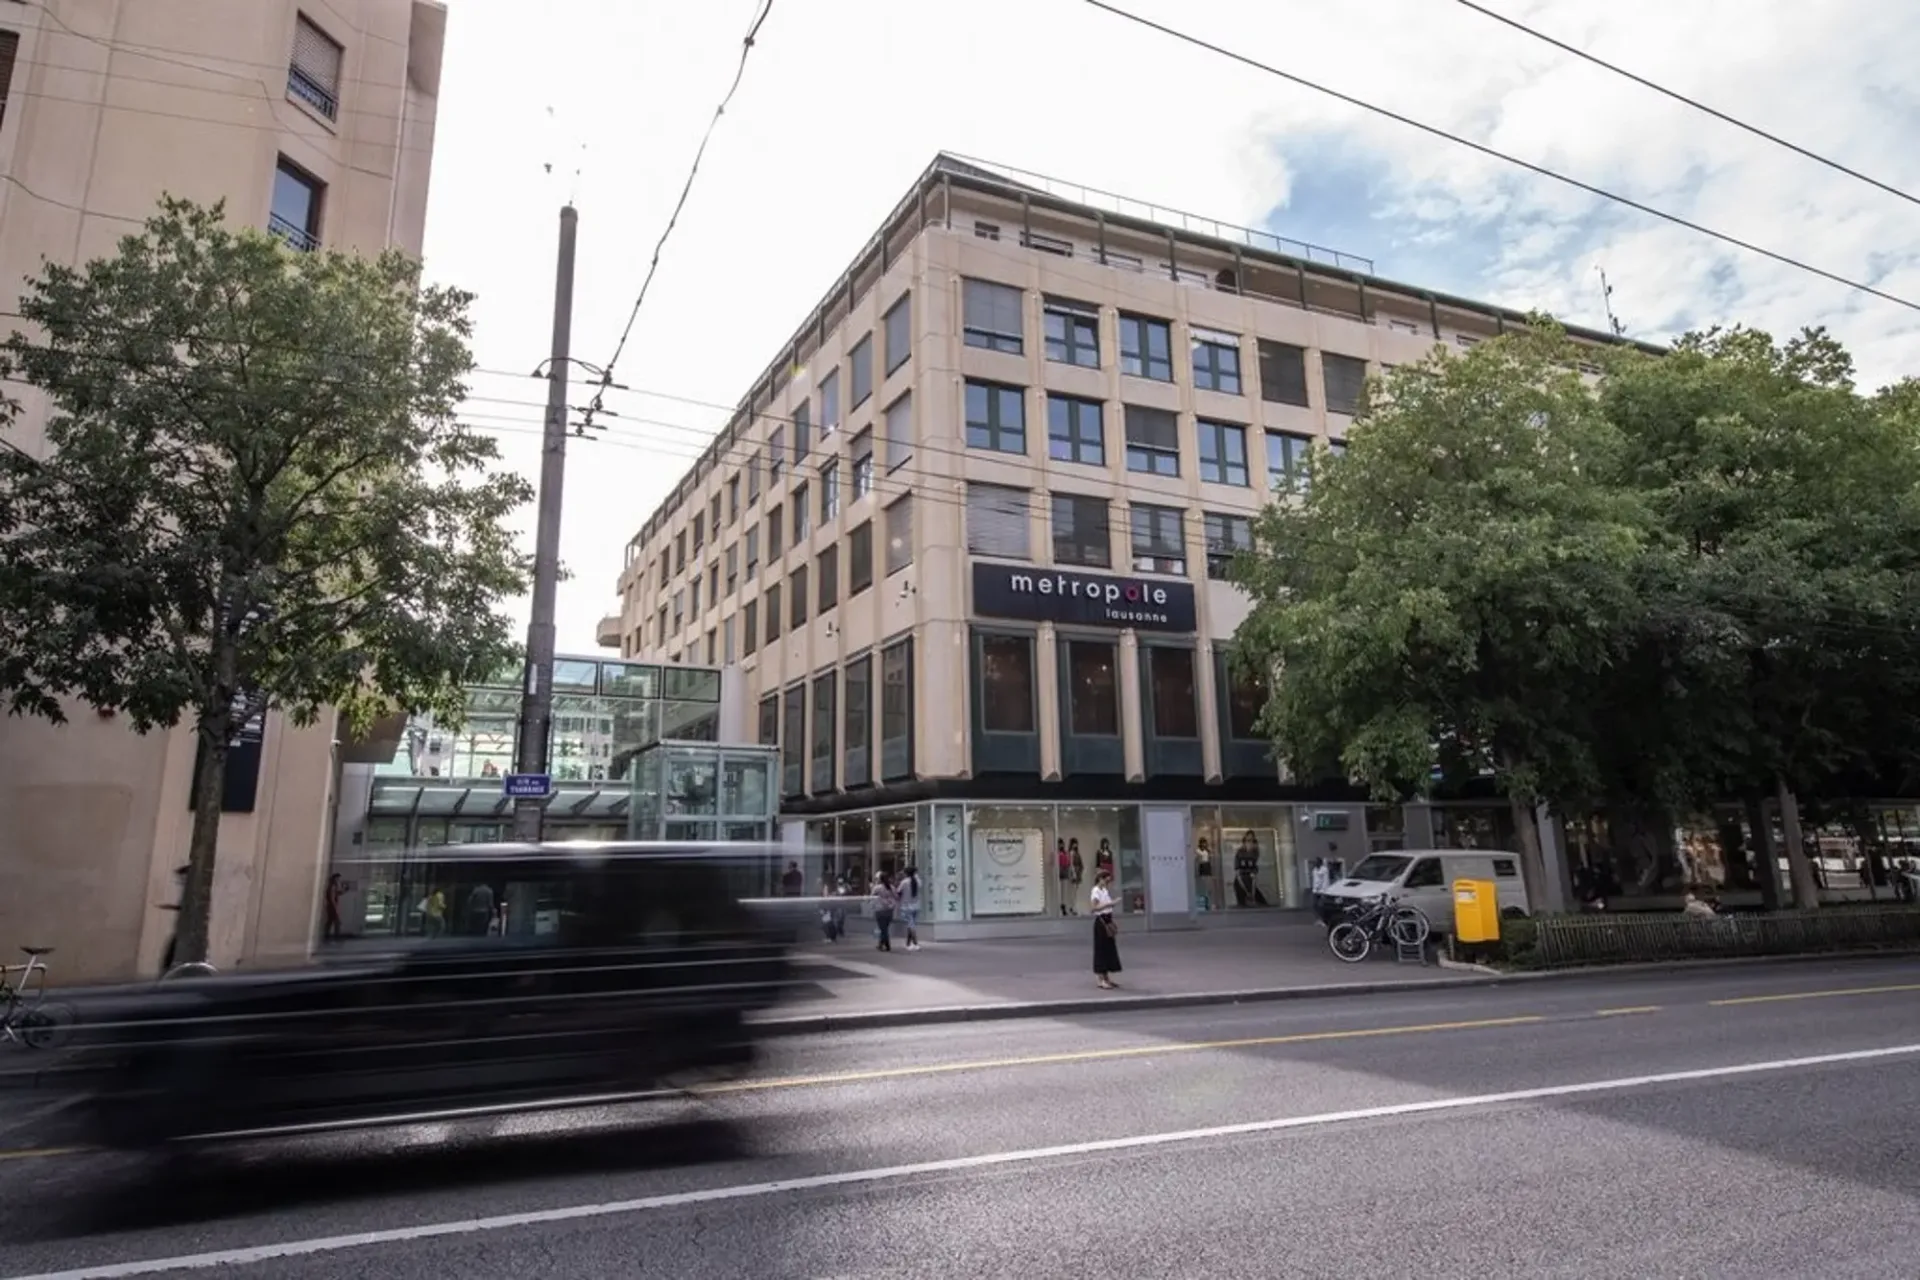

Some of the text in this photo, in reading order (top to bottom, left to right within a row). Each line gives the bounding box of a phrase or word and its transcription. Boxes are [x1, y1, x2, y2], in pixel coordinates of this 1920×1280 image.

[1011, 574, 1167, 604] metropole
[1106, 607, 1167, 622] lausanne
[946, 814, 957, 912] MORGAN
